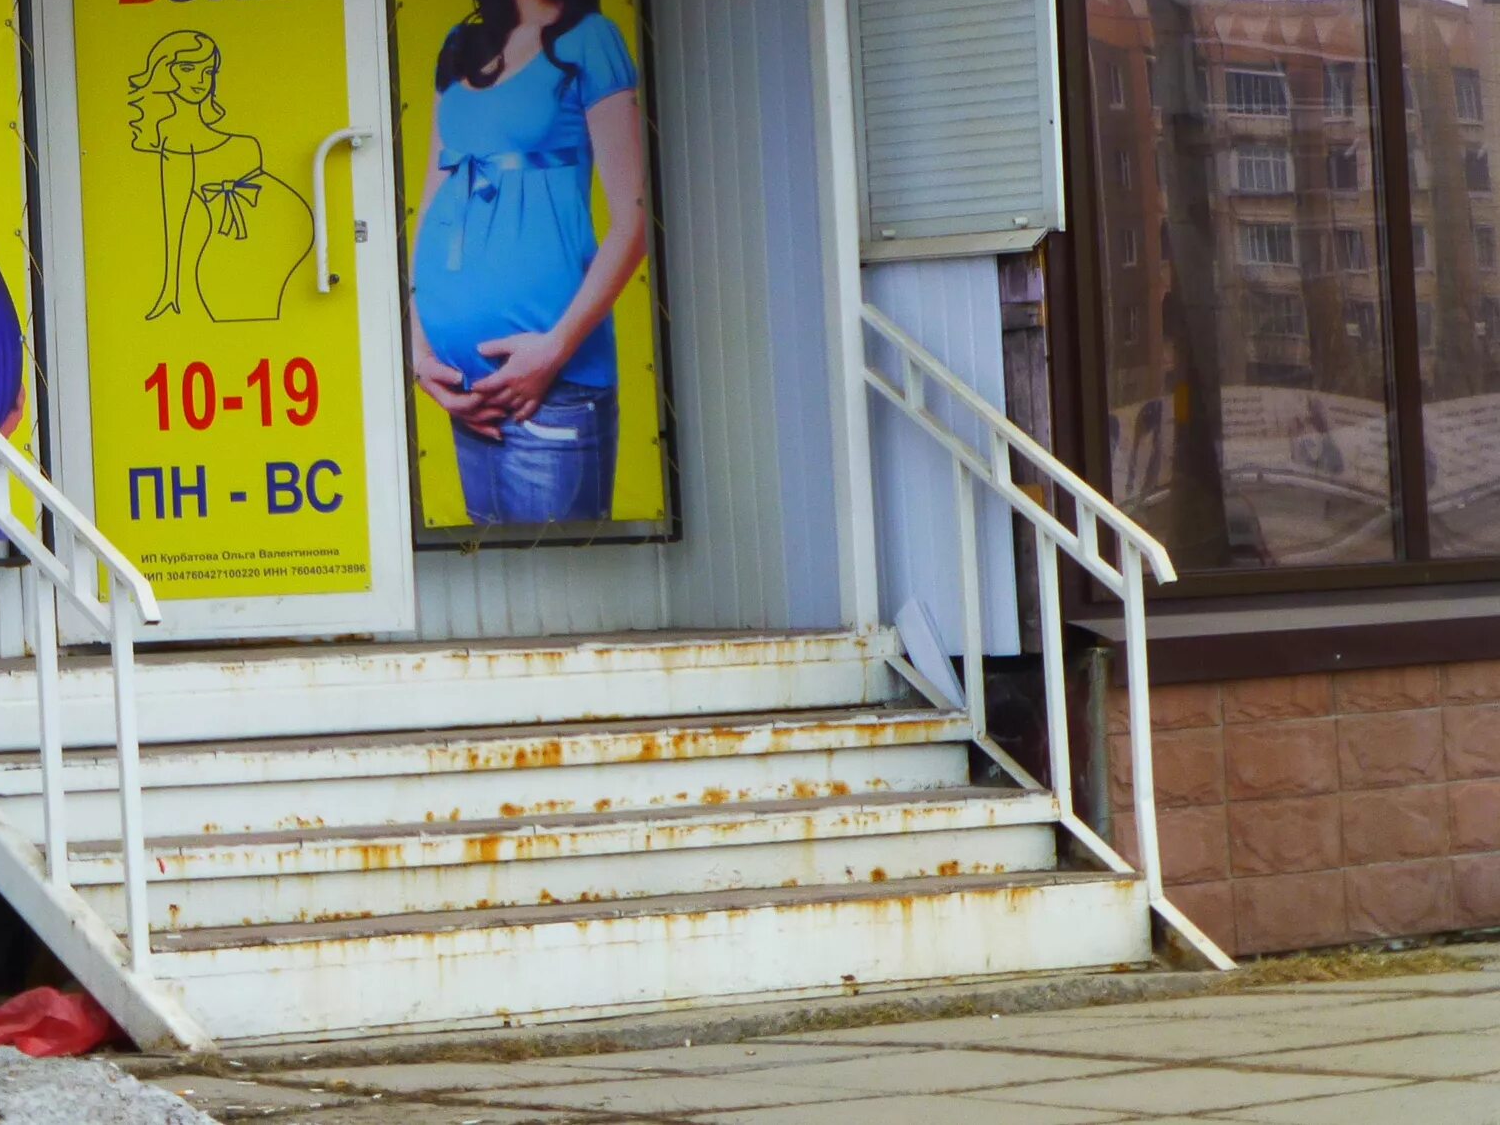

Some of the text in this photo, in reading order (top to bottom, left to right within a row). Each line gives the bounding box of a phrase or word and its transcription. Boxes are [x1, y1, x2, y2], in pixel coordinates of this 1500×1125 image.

[144, 356, 320, 432] 10-19
[128, 464, 208, 521] ПН
[265, 458, 344, 516] ВС
[141, 547, 340, 566] ИП Курбатова Ольга Валентиновна
[263, 566, 288, 578] ИНН
